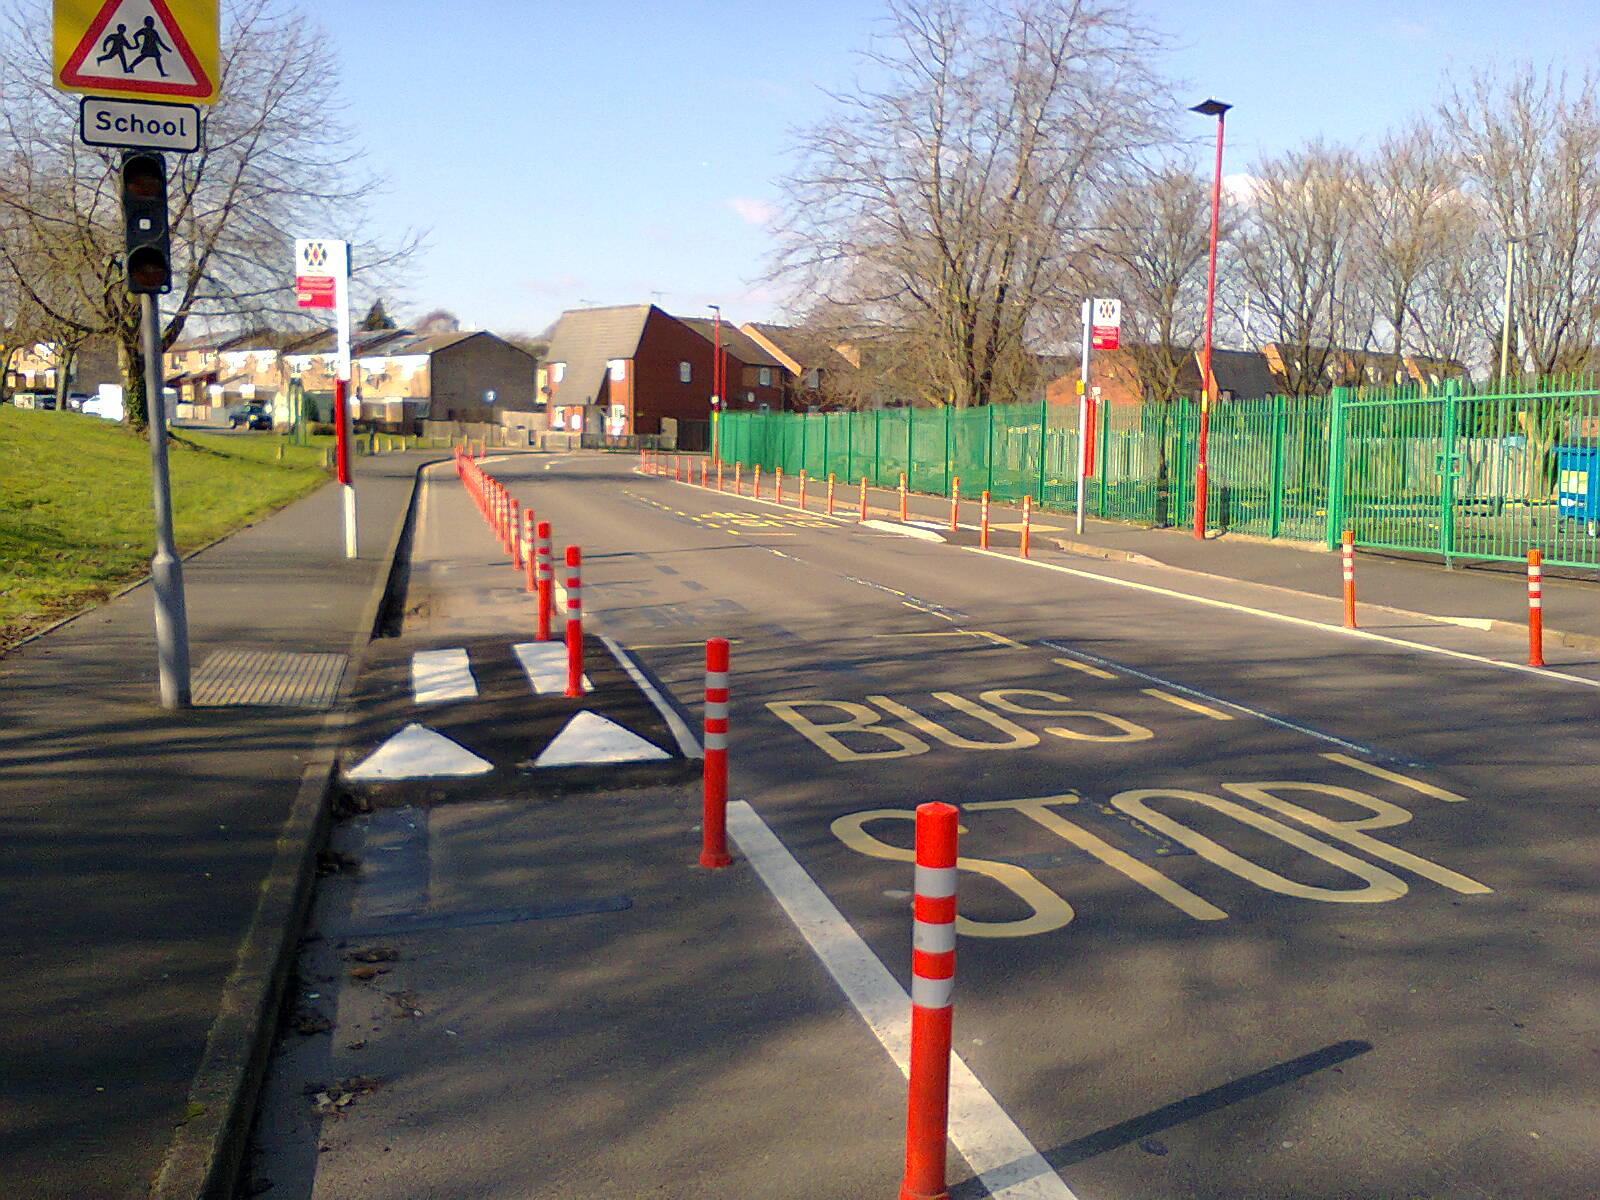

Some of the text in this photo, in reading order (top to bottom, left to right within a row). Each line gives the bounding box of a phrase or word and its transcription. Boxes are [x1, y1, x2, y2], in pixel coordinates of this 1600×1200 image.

[95, 111, 187, 137] School
[765, 687, 1155, 763] BUS
[829, 781, 1494, 939] STOP
